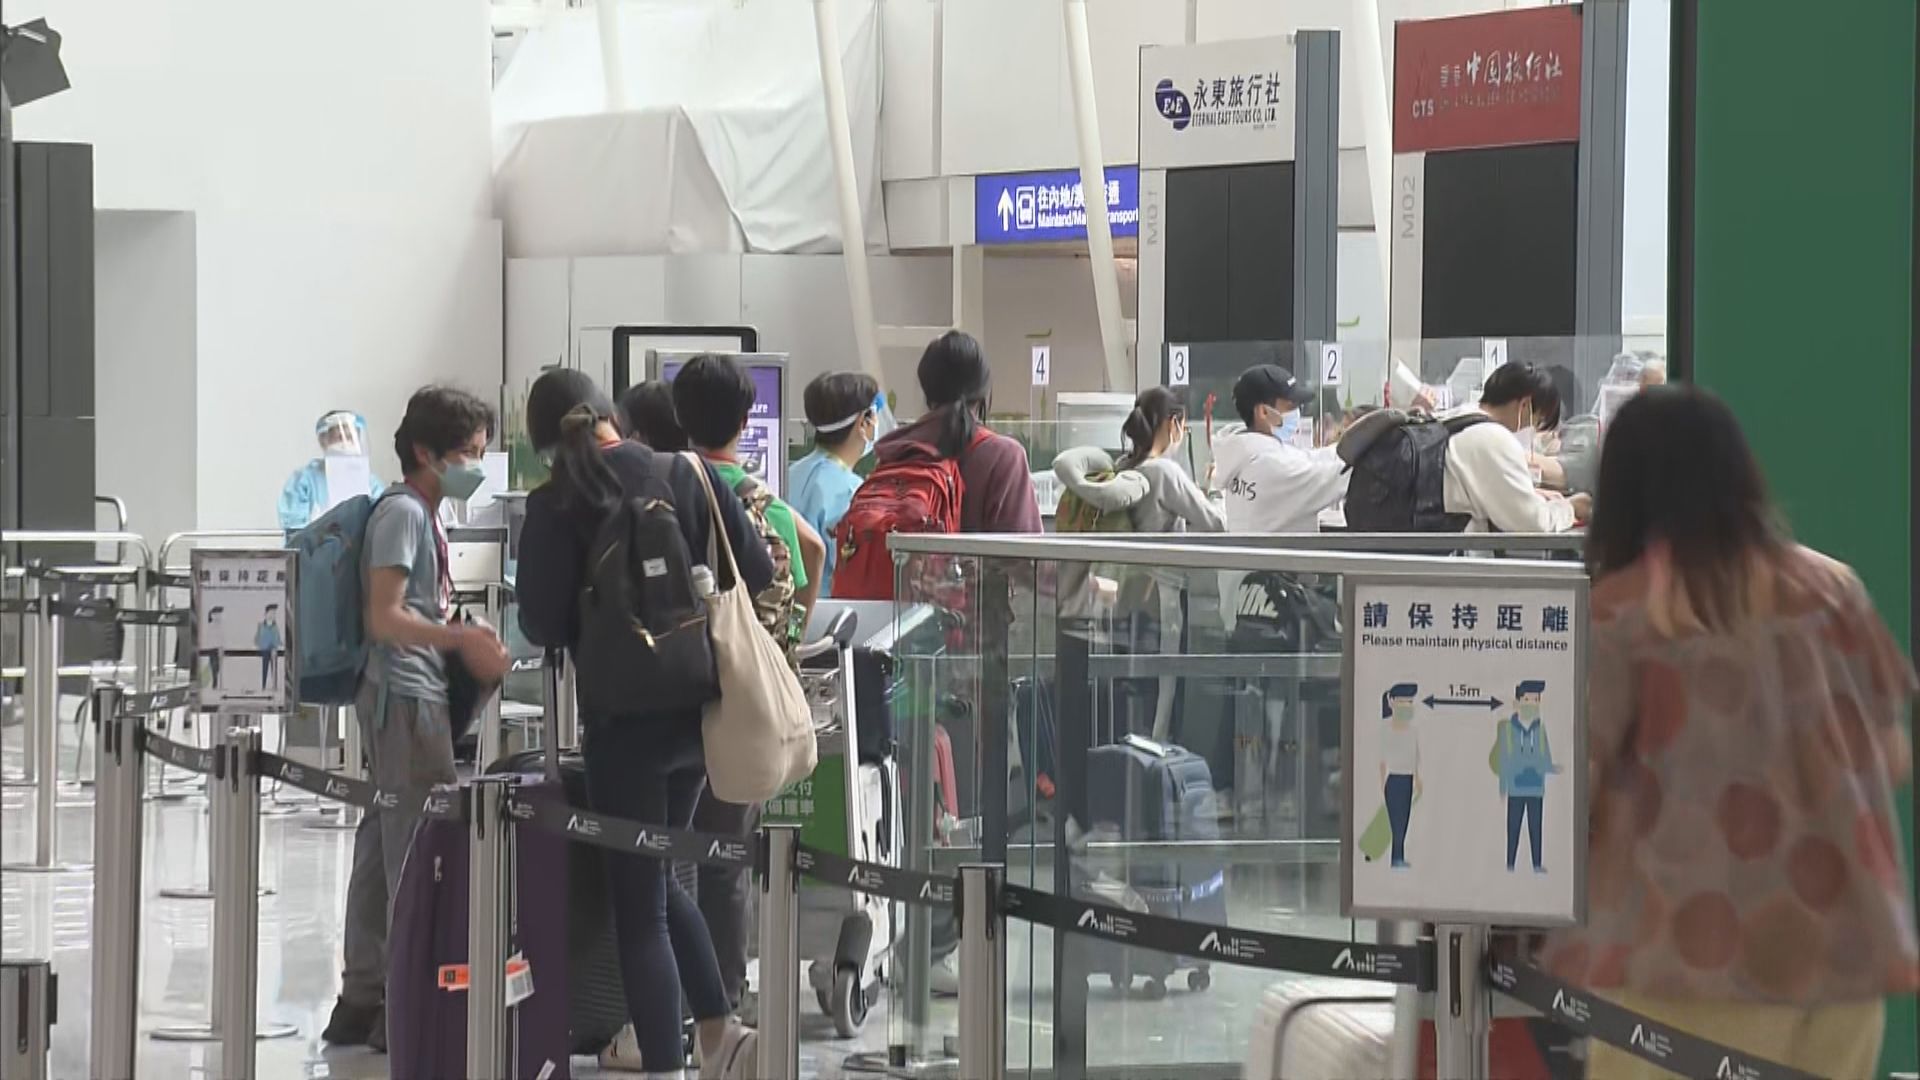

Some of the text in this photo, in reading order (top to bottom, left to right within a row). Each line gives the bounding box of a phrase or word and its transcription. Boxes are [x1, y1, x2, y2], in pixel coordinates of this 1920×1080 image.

[1192, 72, 1281, 110] 永東旅行社
[1217, 110, 1232, 126] EAST
[1232, 109, 1252, 125] TOURS
[1412, 99, 1435, 118] CTS
[1036, 351, 1046, 382] 4
[1174, 351, 1185, 382] 3
[1327, 350, 1338, 380] 2
[1363, 602, 1568, 632] 請保持距離
[1362, 634, 1568, 651] Please maintain physical distance
[1448, 684, 1481, 698] 1.5m
